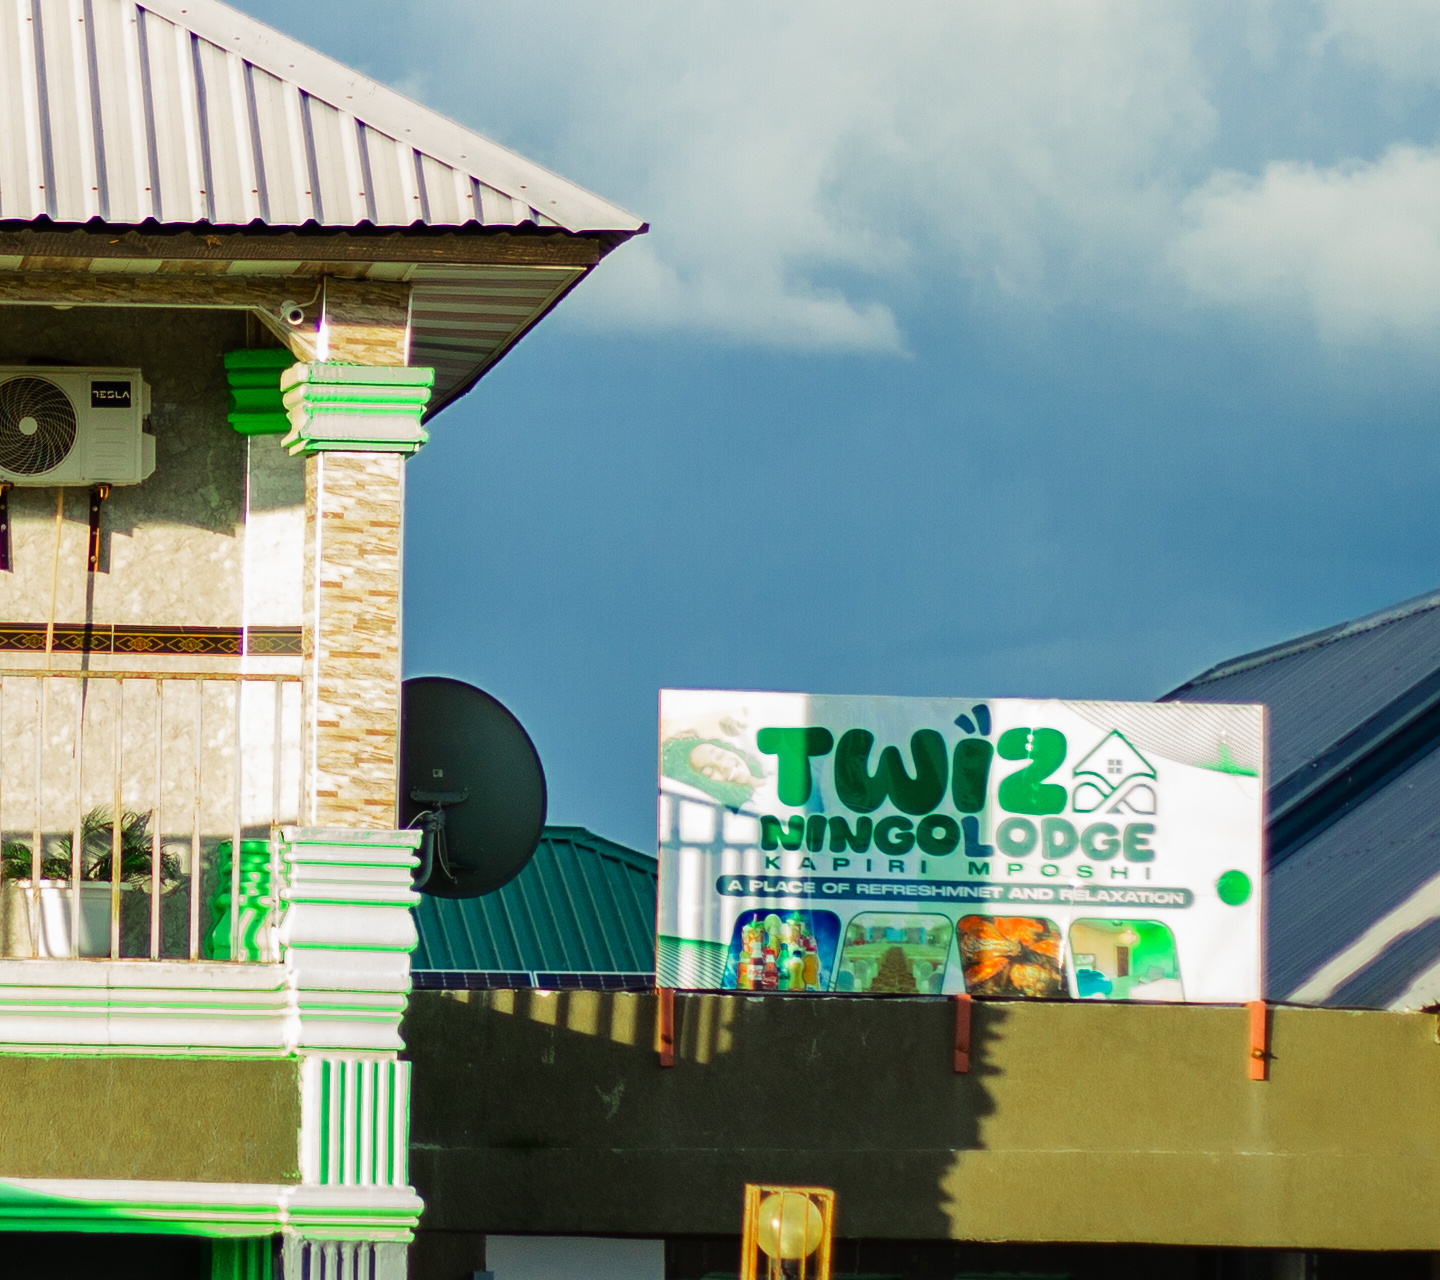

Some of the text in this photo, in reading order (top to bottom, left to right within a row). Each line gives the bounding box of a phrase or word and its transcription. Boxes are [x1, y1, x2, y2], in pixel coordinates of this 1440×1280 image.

[92, 390, 130, 399] TESLA
[765, 856, 1152, 880] KAPIRI MPOSHI
[727, 879, 1185, 905] A PLACE OF REFRESHMNET AND RELAXATION
